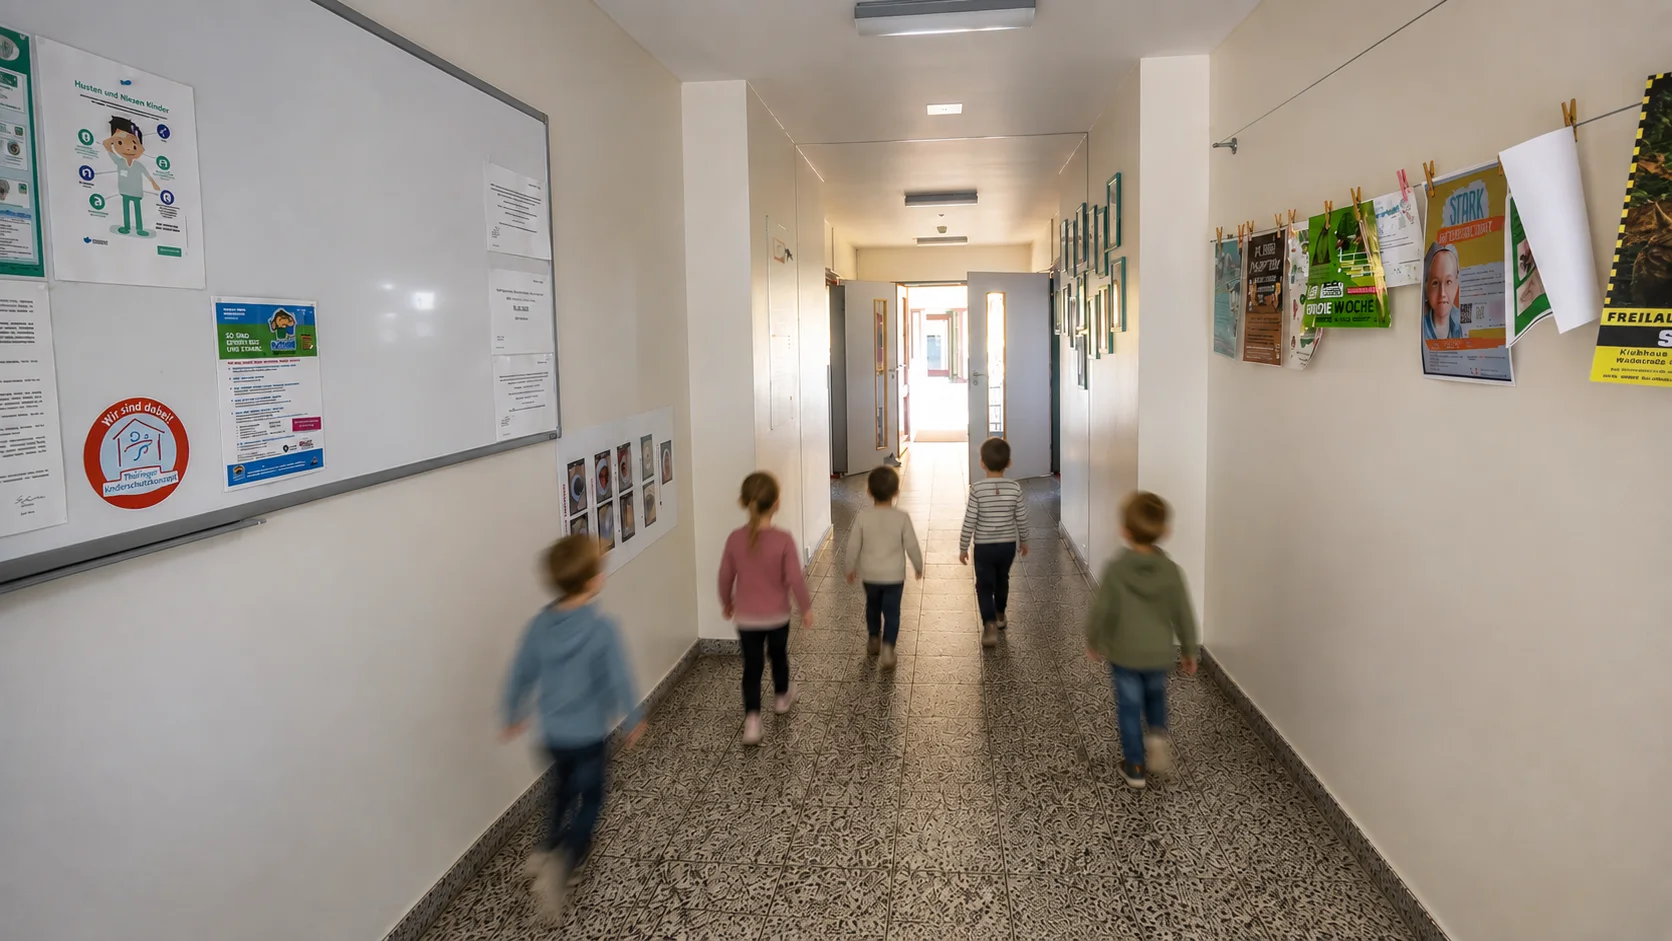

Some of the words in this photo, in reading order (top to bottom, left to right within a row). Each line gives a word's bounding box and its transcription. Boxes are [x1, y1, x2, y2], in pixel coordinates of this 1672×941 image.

[75, 80, 102, 94] Husten
[105, 90, 118, 99] und
[146, 101, 169, 114] Kinder
[1450, 187, 1484, 226] STARK
[1334, 299, 1375, 314] WOCHE
[101, 410, 119, 427] Wir
[120, 401, 142, 415] sind
[144, 402, 174, 425] dabei!
